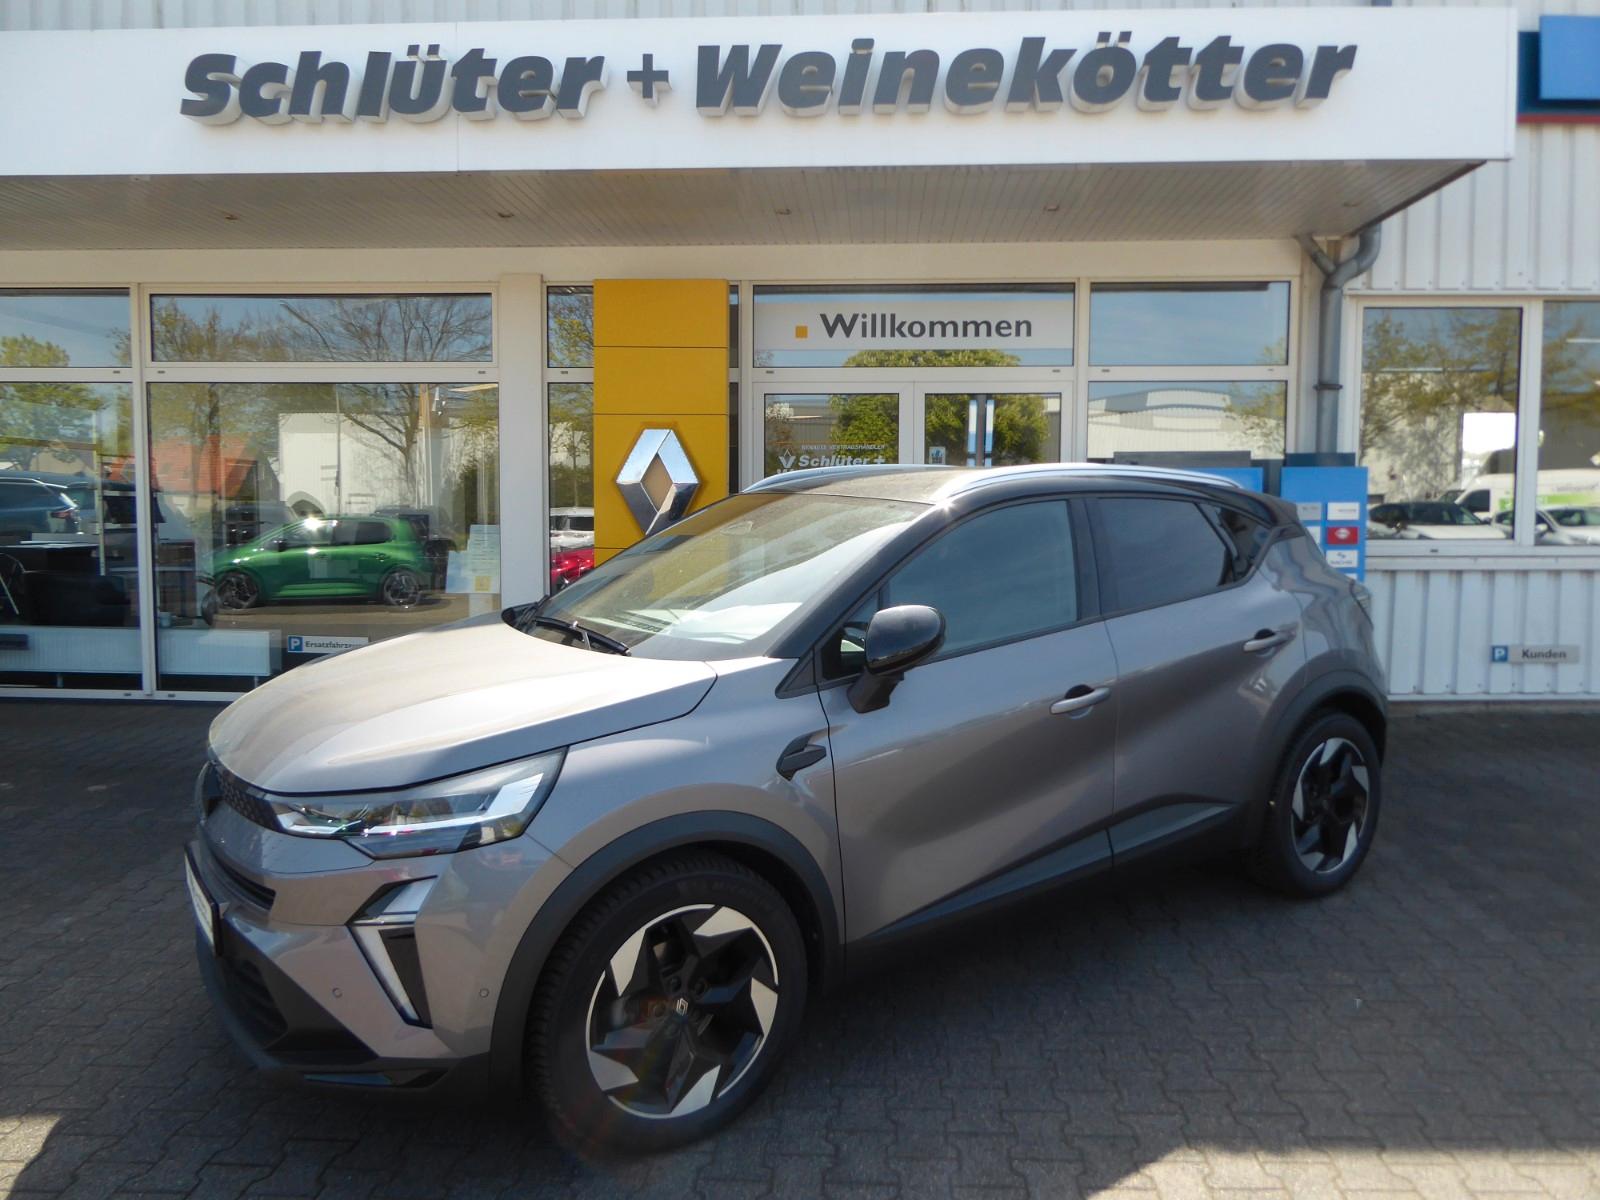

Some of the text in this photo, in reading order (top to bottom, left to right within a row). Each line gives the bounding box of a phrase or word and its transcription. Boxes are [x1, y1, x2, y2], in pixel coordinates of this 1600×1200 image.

[180, 31, 1358, 122] Schlüter + Weinekötter
[819, 313, 1033, 338] Willkommen
[798, 455, 871, 467] Schlüter
[290, 637, 361, 650] P Ersatzfahrze
[1494, 647, 1567, 661] P Kunden
